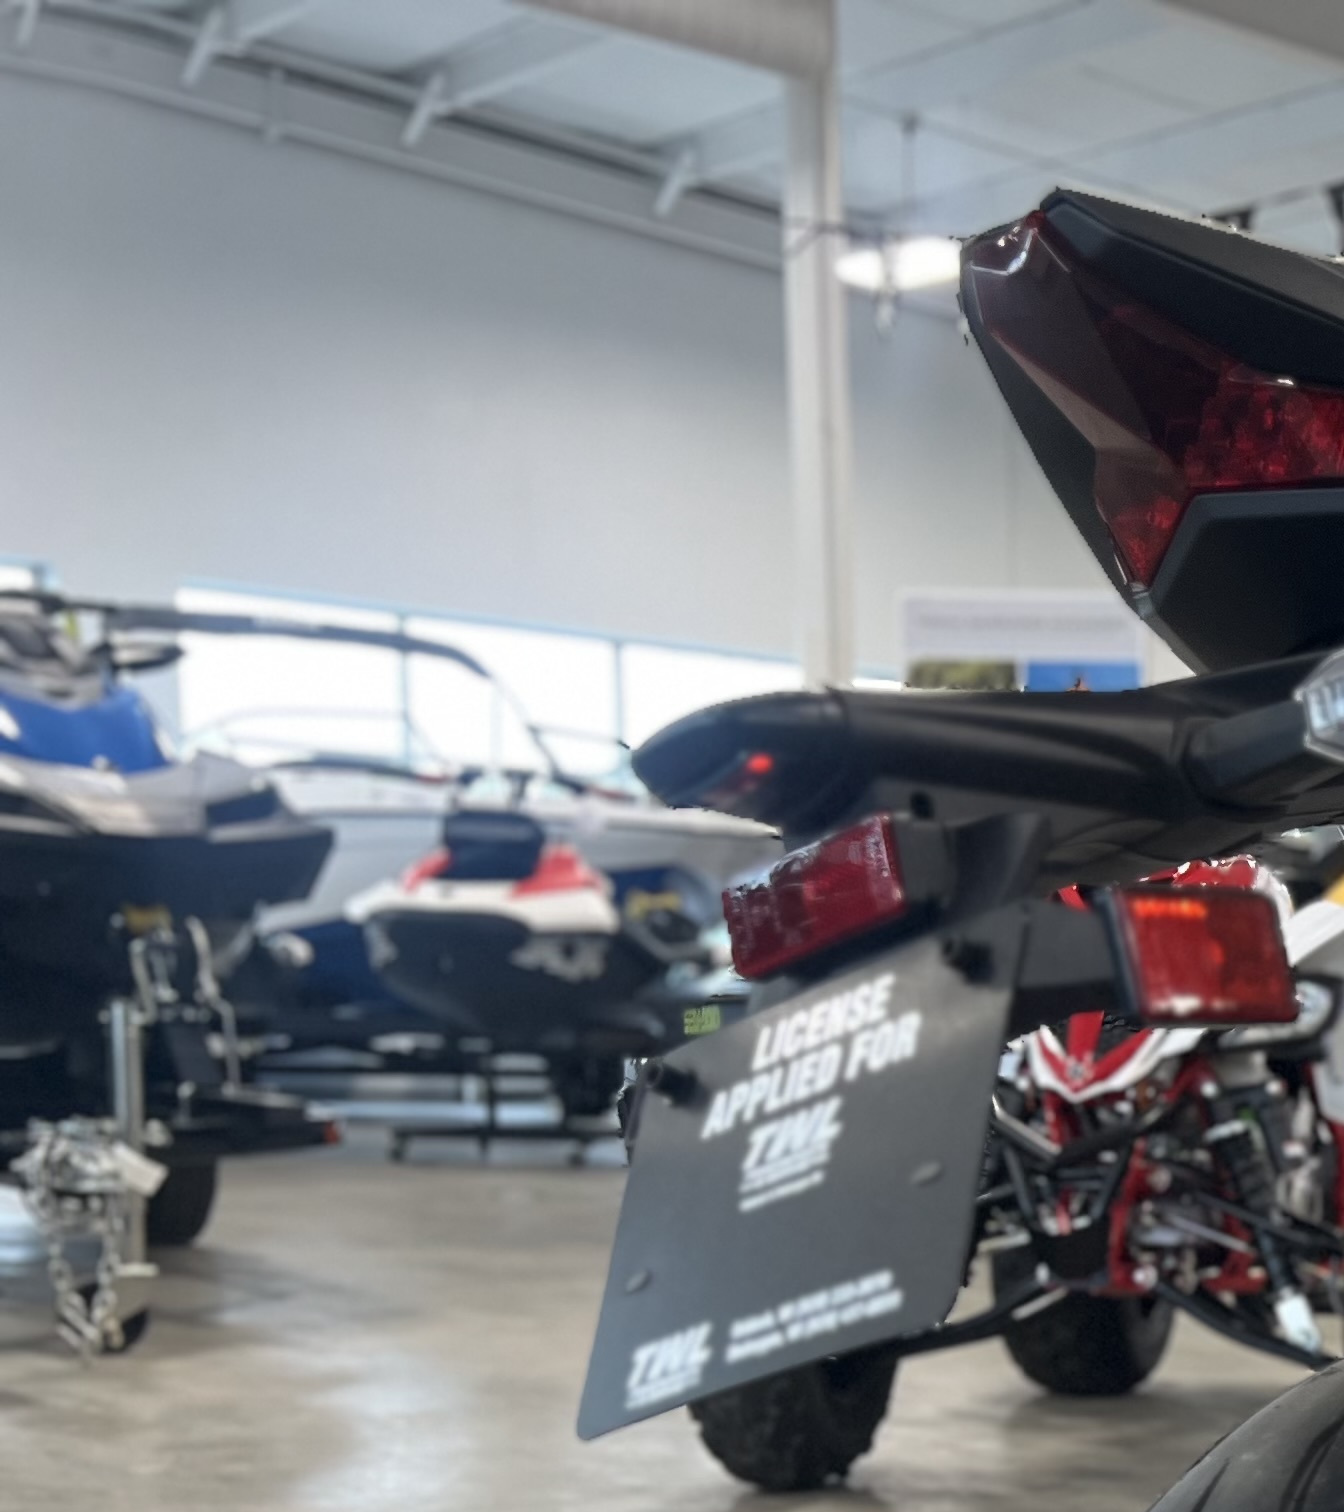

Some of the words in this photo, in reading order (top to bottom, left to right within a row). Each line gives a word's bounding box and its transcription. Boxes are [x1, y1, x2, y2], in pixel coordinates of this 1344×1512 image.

[701, 1042, 842, 1139] APPLIED
[844, 1010, 922, 1082] FOR
[752, 972, 896, 1072] LICENSE
